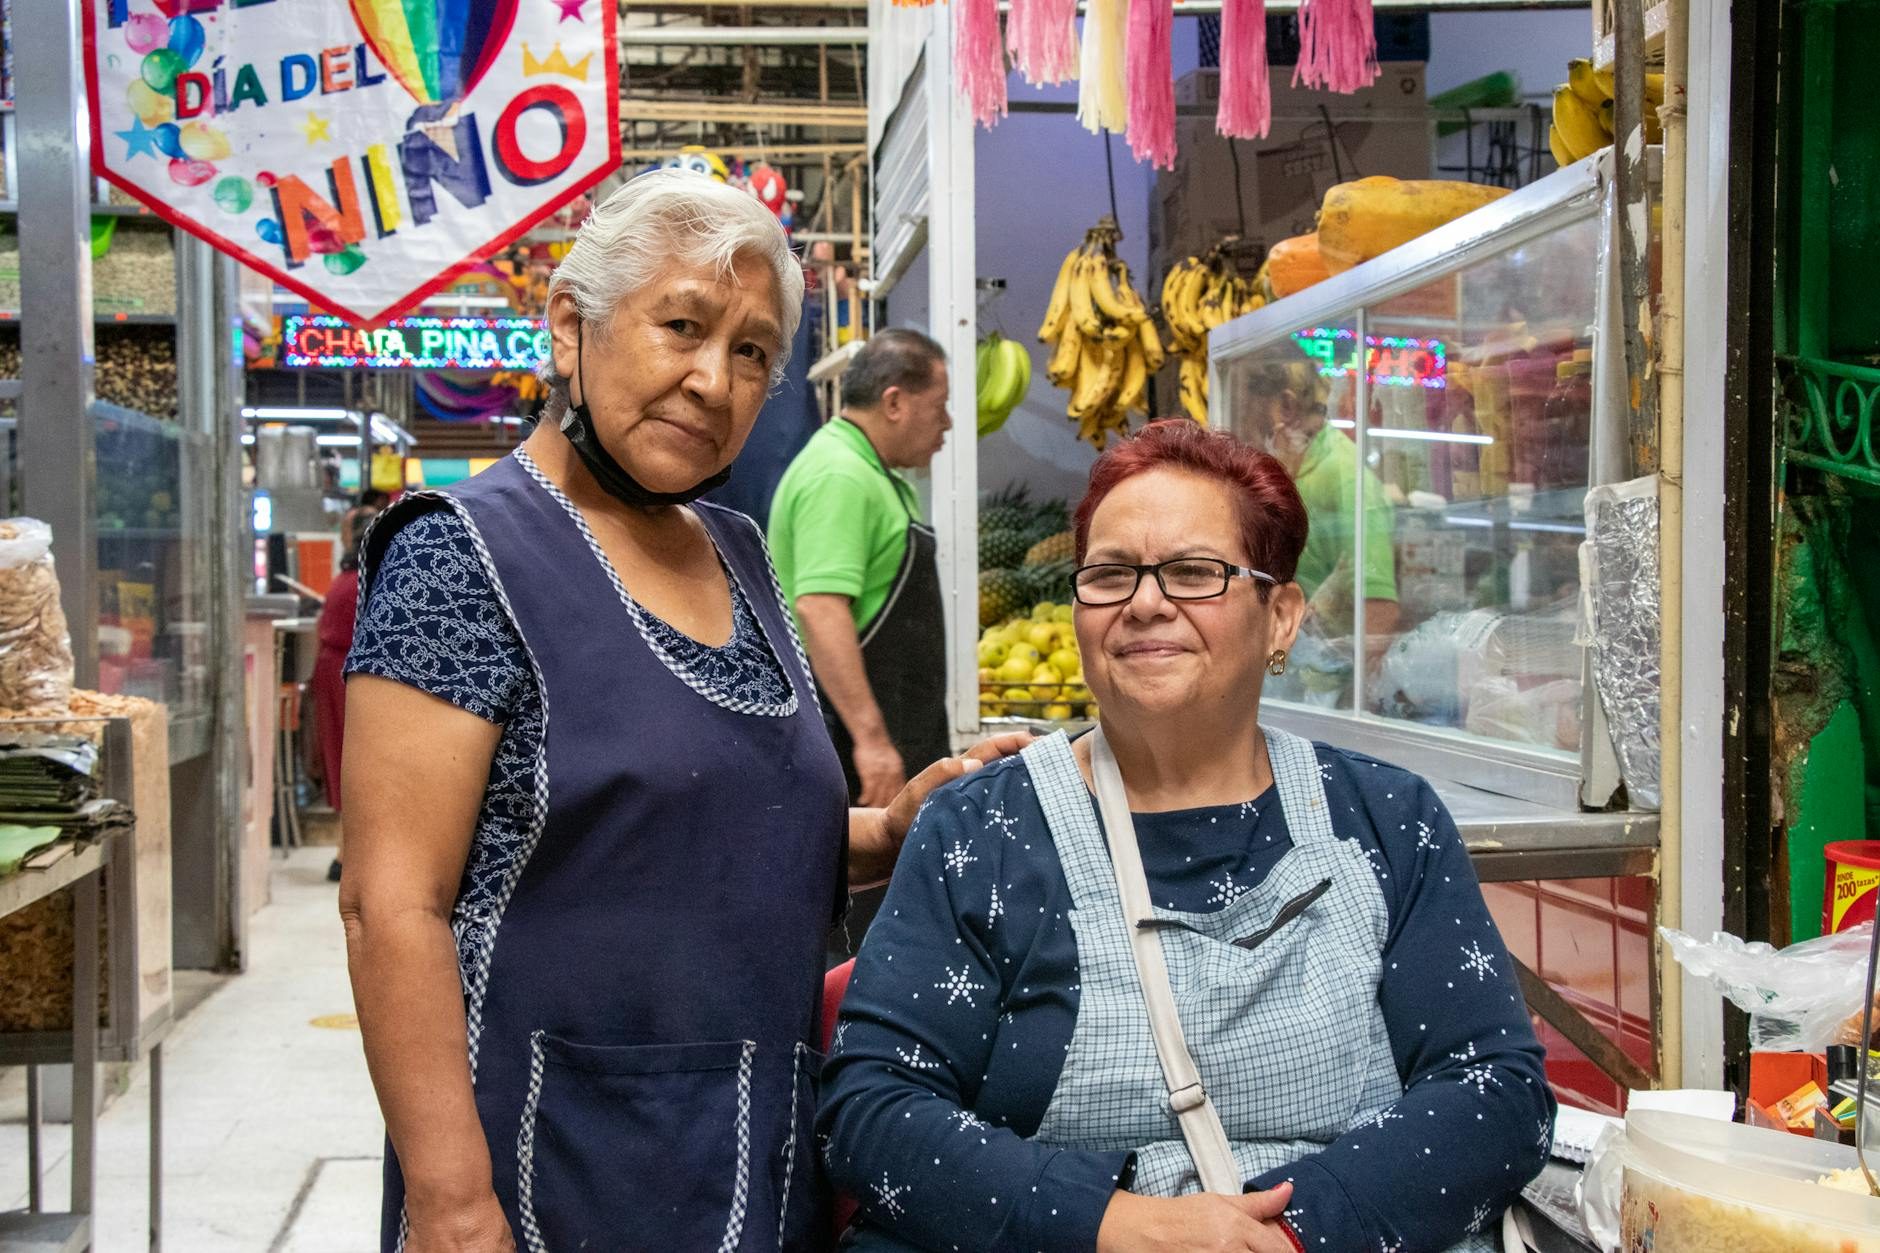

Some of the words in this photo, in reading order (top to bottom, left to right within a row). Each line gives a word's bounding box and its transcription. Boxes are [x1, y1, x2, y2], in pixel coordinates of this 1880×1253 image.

[174, 55, 268, 120] DÍA
[280, 43, 386, 102] DEL
[269, 83, 587, 270] NIÑO
[1837, 871, 1854, 882] RINDE
[1837, 881, 1856, 900] 200
